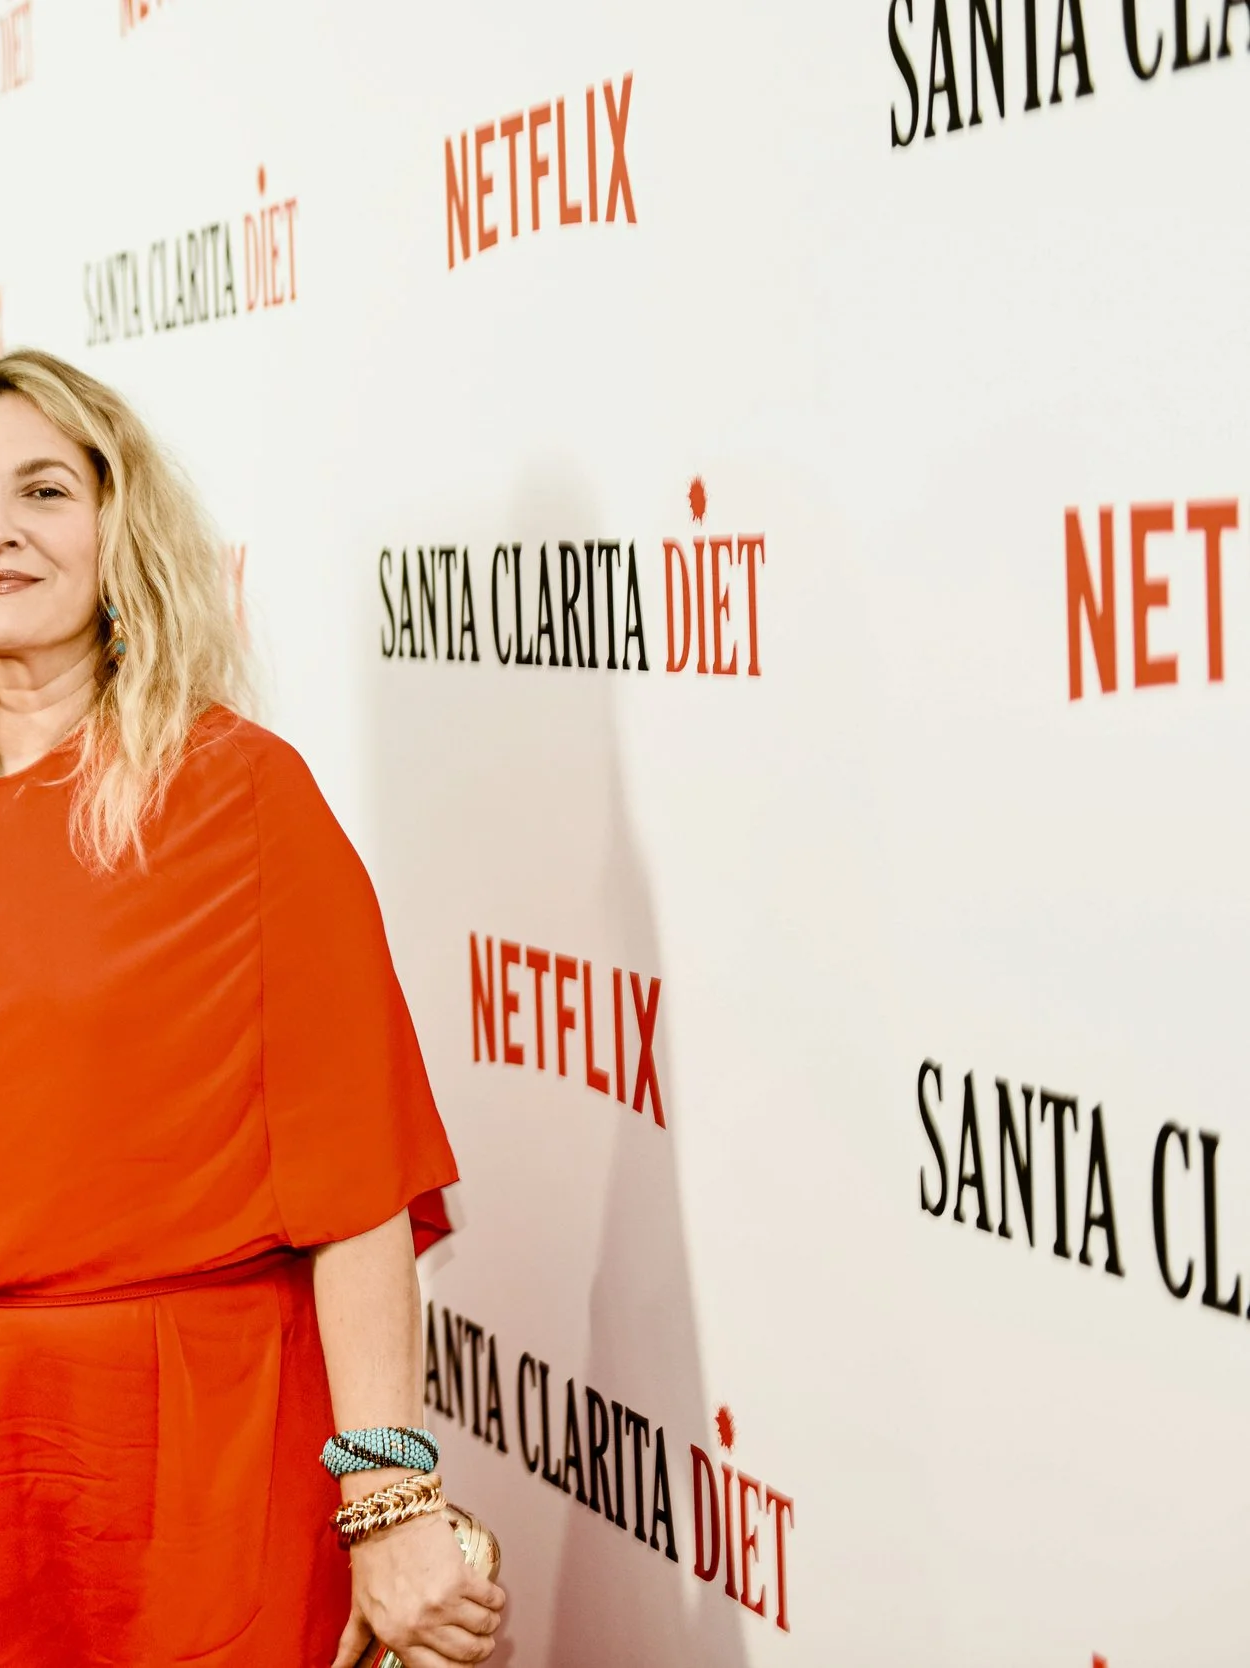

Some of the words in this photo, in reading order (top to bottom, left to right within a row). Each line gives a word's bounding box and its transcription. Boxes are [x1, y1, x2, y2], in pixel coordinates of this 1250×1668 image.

[444, 72, 639, 271] NETFLIX
[887, 0, 1095, 149] SANTA
[244, 196, 299, 312] DIET
[379, 545, 481, 664] SANTA
[490, 539, 650, 672] CLARITA
[662, 534, 766, 677] DIET
[1063, 498, 1240, 702] NET
[469, 931, 667, 1130] NETFLIX
[917, 1058, 1126, 1278] SANTA
[1152, 1120, 1250, 1322] CL
[424, 1300, 509, 1455] ANTA
[517, 1351, 679, 1564] CLARITA
[690, 1443, 795, 1633] DIET
